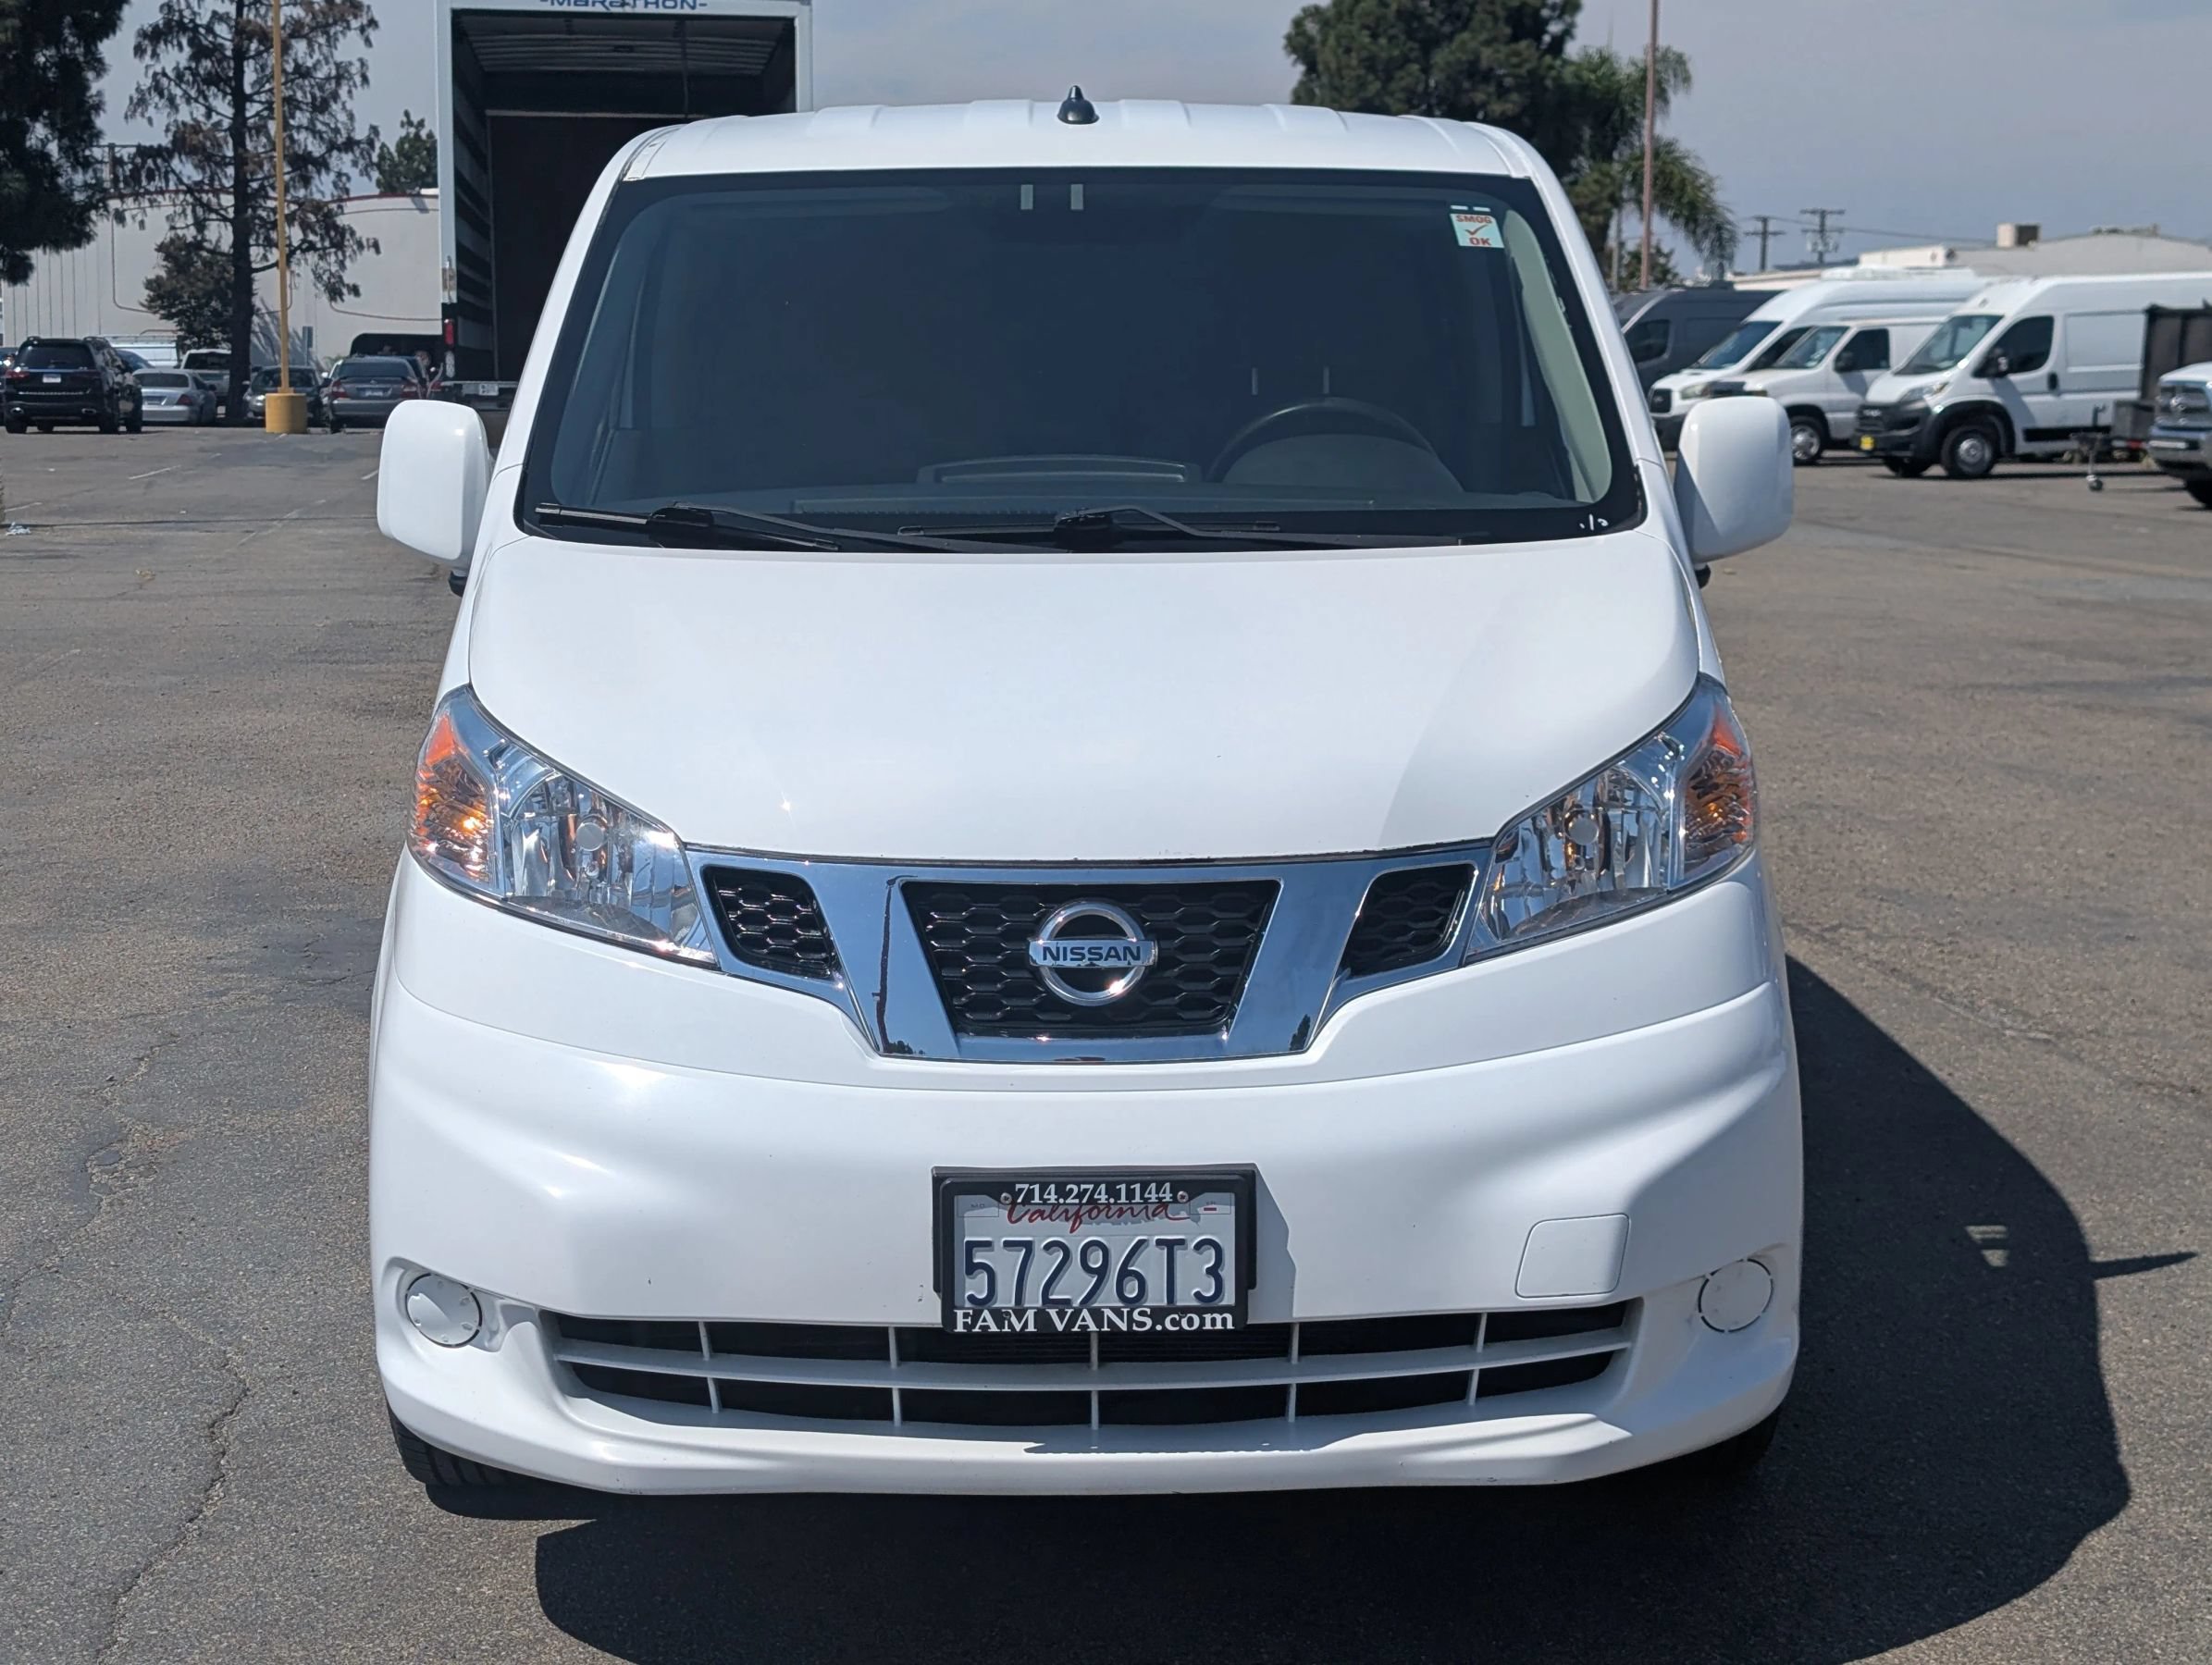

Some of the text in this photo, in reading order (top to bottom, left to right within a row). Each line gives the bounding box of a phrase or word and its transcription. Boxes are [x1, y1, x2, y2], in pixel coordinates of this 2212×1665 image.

[1456, 215, 1492, 224] SMOG
[1469, 237, 1491, 246] OK
[1043, 946, 1141, 961] NISSAN
[1015, 1182, 1173, 1203] 714.274.1144
[1007, 1202, 1191, 1234] California
[964, 1236, 1225, 1306] 57296T3
[954, 1307, 1236, 1332] FAM VANS.com
